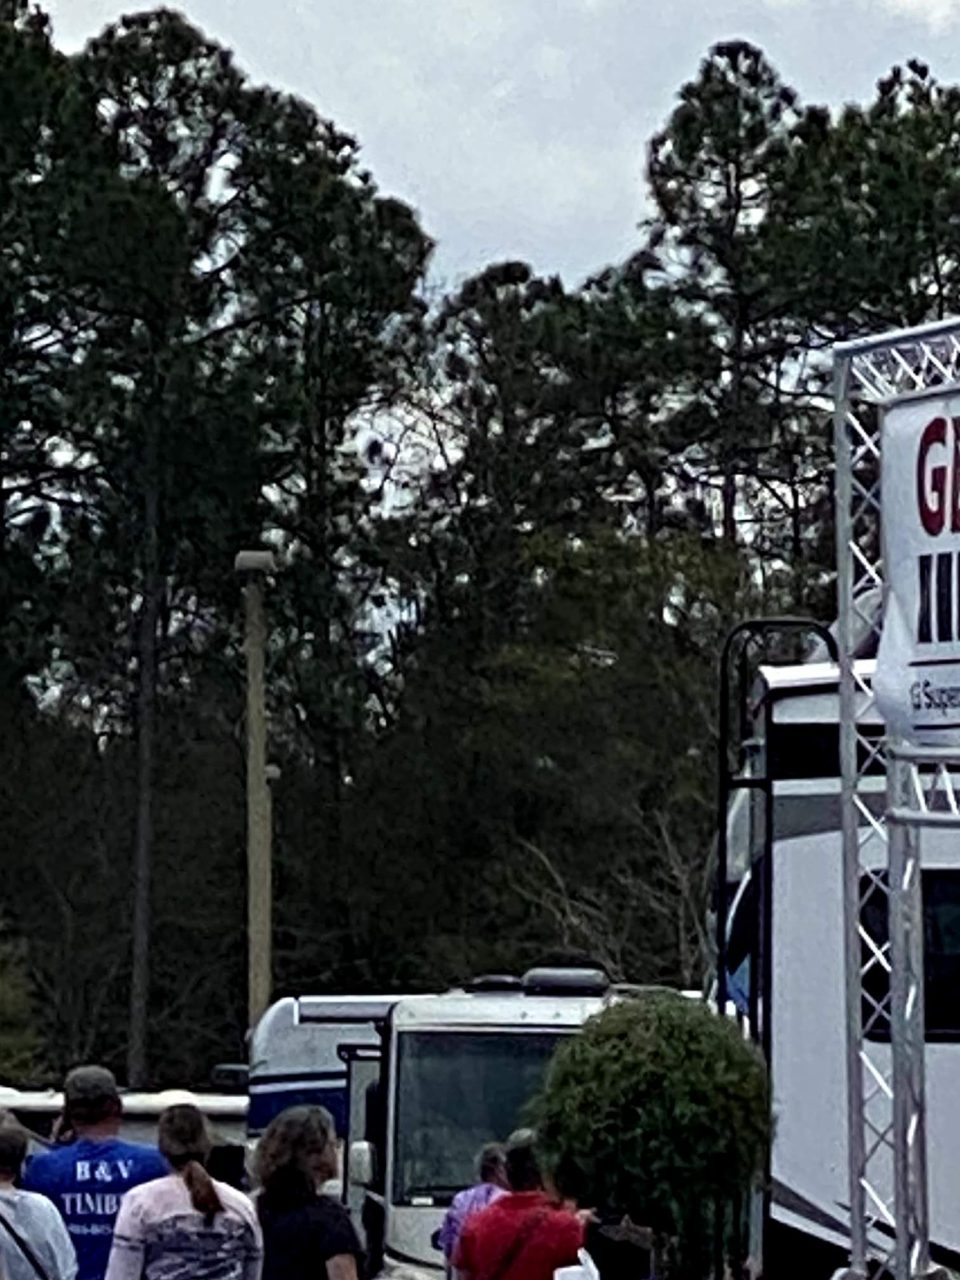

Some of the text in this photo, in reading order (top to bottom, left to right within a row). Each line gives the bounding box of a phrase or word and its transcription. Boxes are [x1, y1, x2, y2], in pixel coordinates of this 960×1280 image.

[76, 1159, 133, 1182] B & V
[61, 1193, 120, 1215] TIMB
